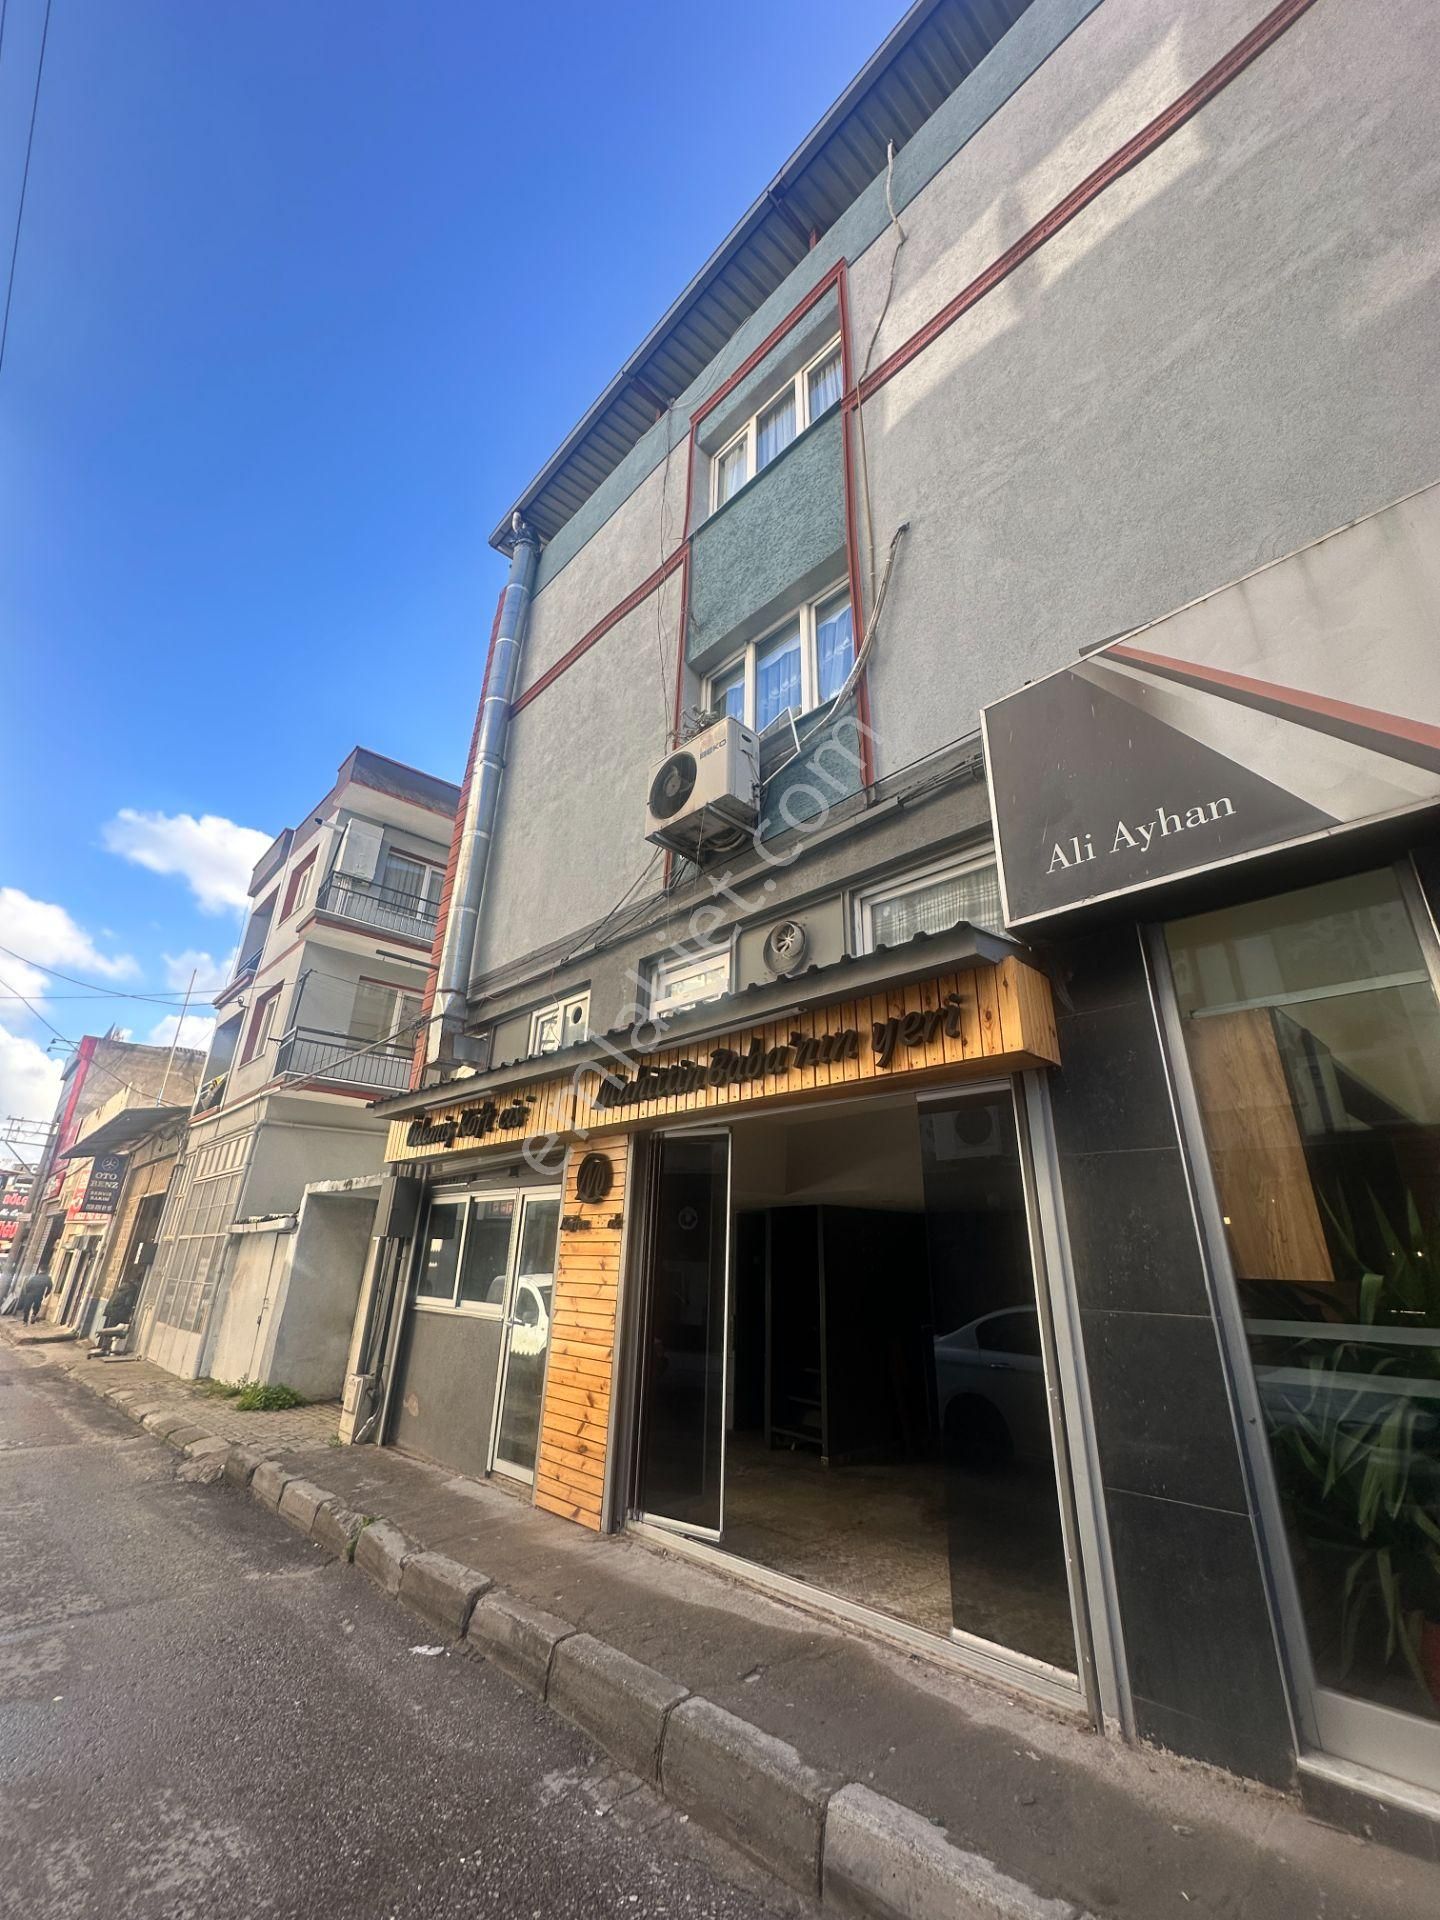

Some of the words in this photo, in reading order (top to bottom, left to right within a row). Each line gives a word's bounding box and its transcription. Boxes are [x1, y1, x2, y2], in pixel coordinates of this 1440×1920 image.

[700, 739, 727, 759] BEKO
[1045, 833, 1096, 874] Ali
[1109, 795, 1237, 852] Ayhan
[871, 993, 963, 1069] yeri
[90, 1180, 119, 1189] BENZ
[95, 1172, 118, 1180] OTO
